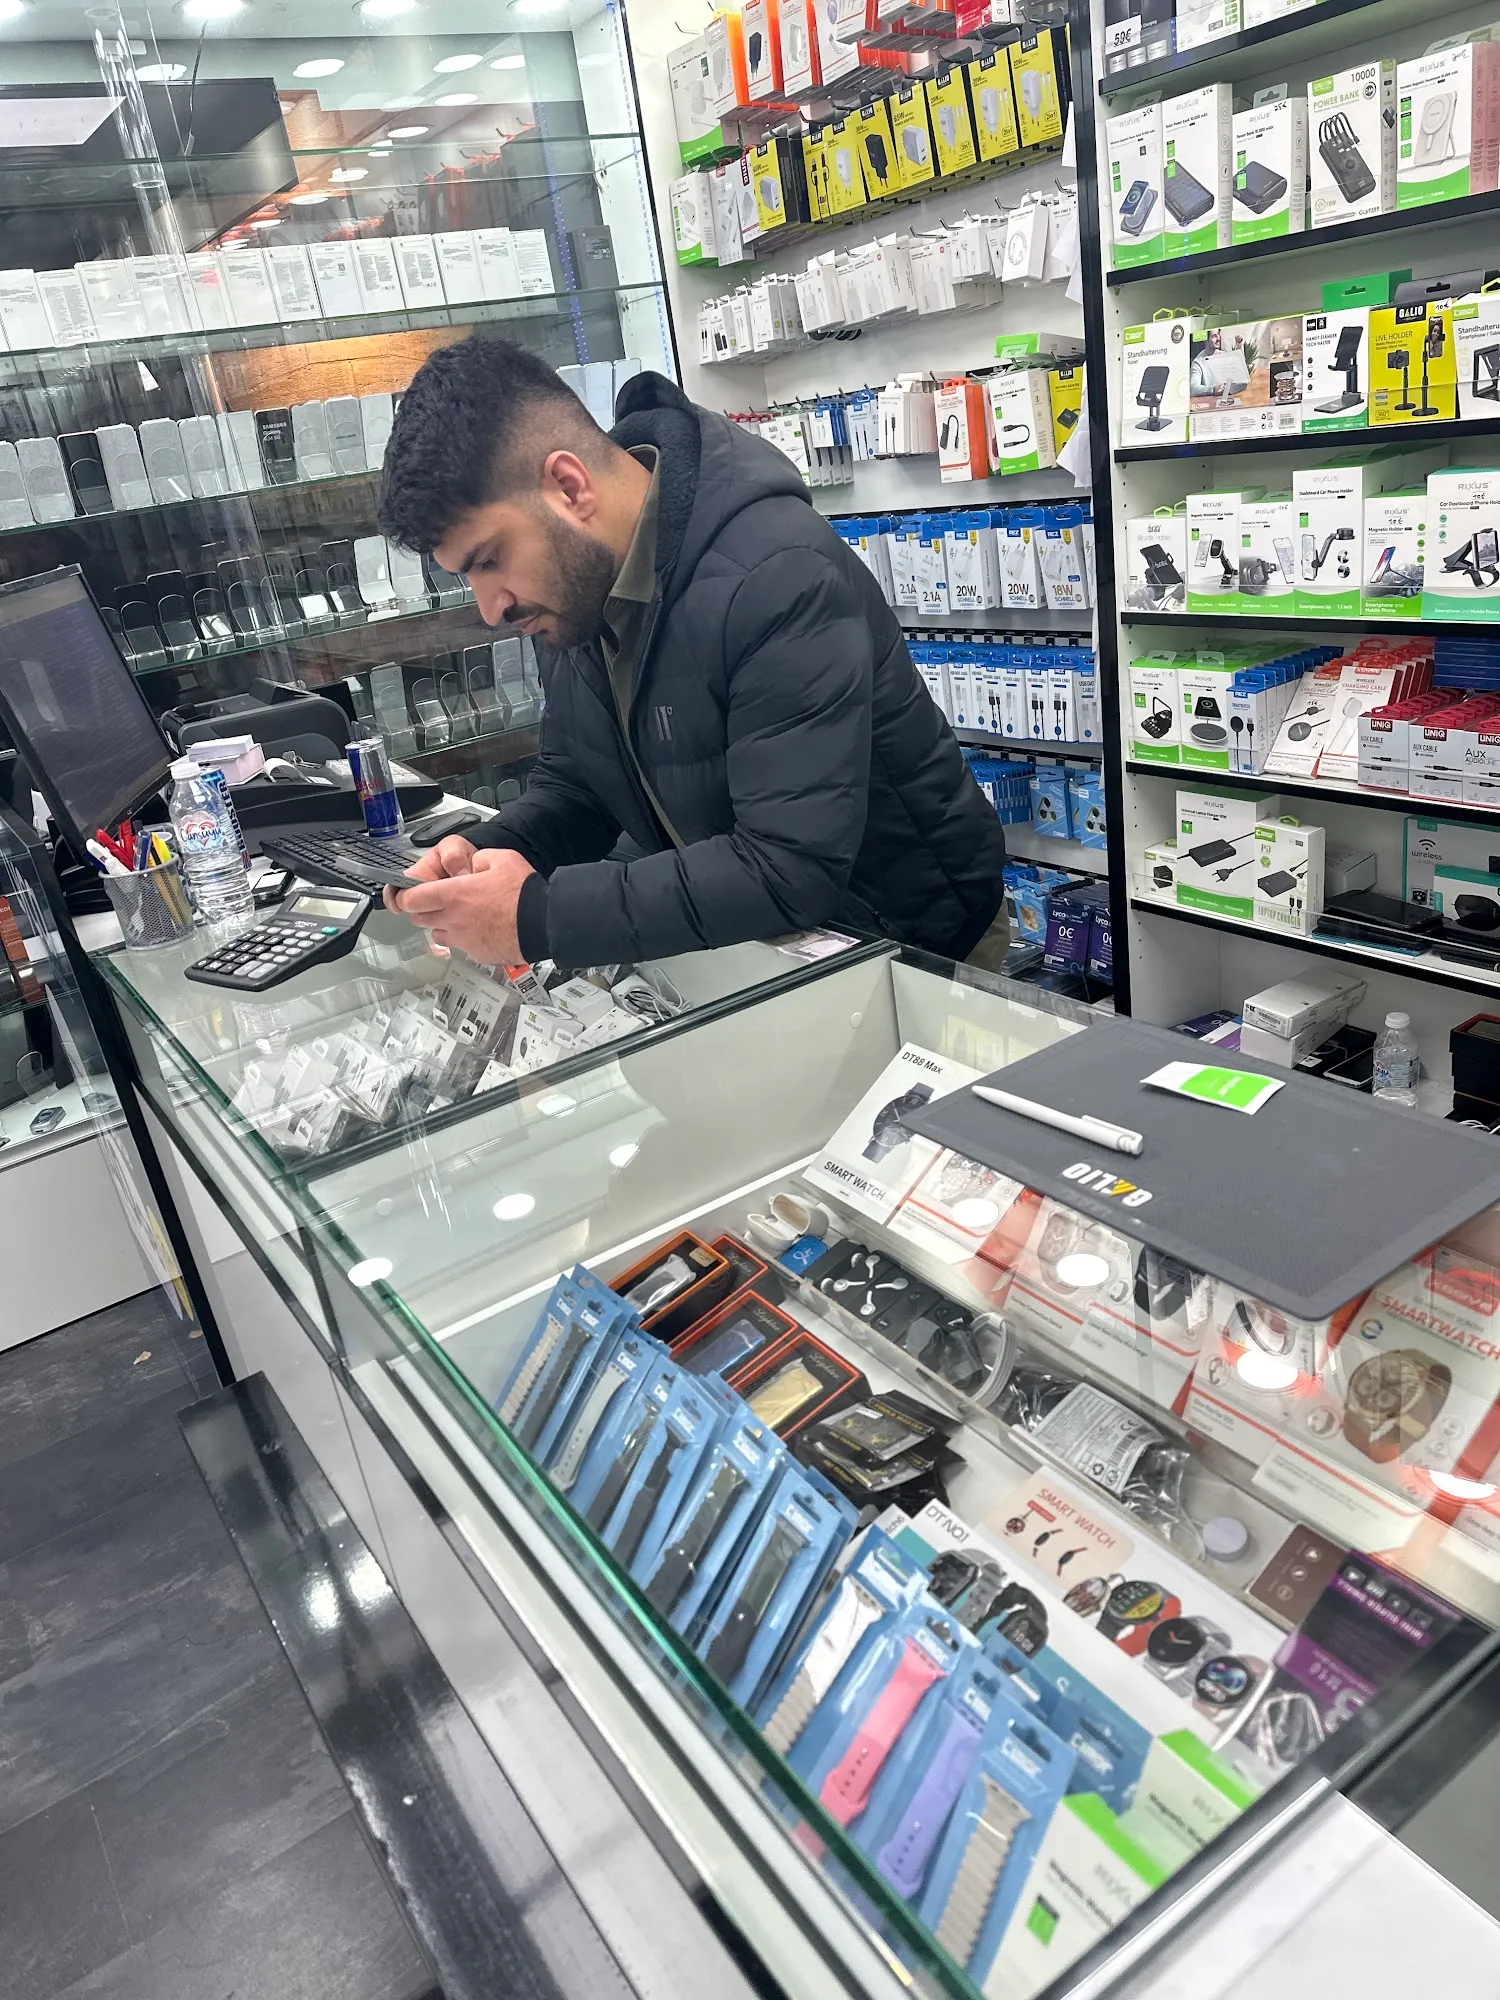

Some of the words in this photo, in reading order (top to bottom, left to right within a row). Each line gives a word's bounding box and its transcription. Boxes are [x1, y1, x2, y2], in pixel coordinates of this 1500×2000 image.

[1419, 60, 1445, 74] RIXUS
[1351, 67, 1376, 82] 10000
[1313, 96, 1338, 110] POWER
[1339, 90, 1360, 102] BANK
[1249, 111, 1271, 124] RIXUS
[1458, 323, 1500, 334] Standhalteru
[1375, 334, 1388, 342] LIVE
[1388, 330, 1413, 341] HOLDER
[1127, 348, 1168, 359] Standhalterung
[262, 421, 287, 430] SAMSUNG
[1313, 475, 1339, 483] RIXUS
[1458, 482, 1489, 490] RIXUS
[1384, 508, 1408, 516] RIXUS
[956, 585, 977, 597] 20W
[1007, 583, 1029, 595] 20W
[1052, 584, 1073, 596] 18W
[923, 591, 941, 602] 2.1A
[1371, 720, 1392, 729] UNIQ
[1369, 735, 1384, 744] CABLE
[1424, 729, 1446, 739] UNIQ
[1412, 743, 1421, 751] AUX
[1421, 744, 1438, 753] CABLE
[180, 826, 222, 844] Cansuyu
[1411, 850, 1443, 861] wireless
[1258, 906, 1276, 919] LAPTOP
[1058, 925, 1075, 939] 0€
[901, 1051, 926, 1067] DT88
[923, 1060, 944, 1075] Max
[823, 1160, 856, 1183] SMART
[853, 1175, 887, 1201] WATCH
[925, 1505, 945, 1523] DT
[1037, 1487, 1078, 1519] SMART
[1075, 1514, 1117, 1549] WATCH
